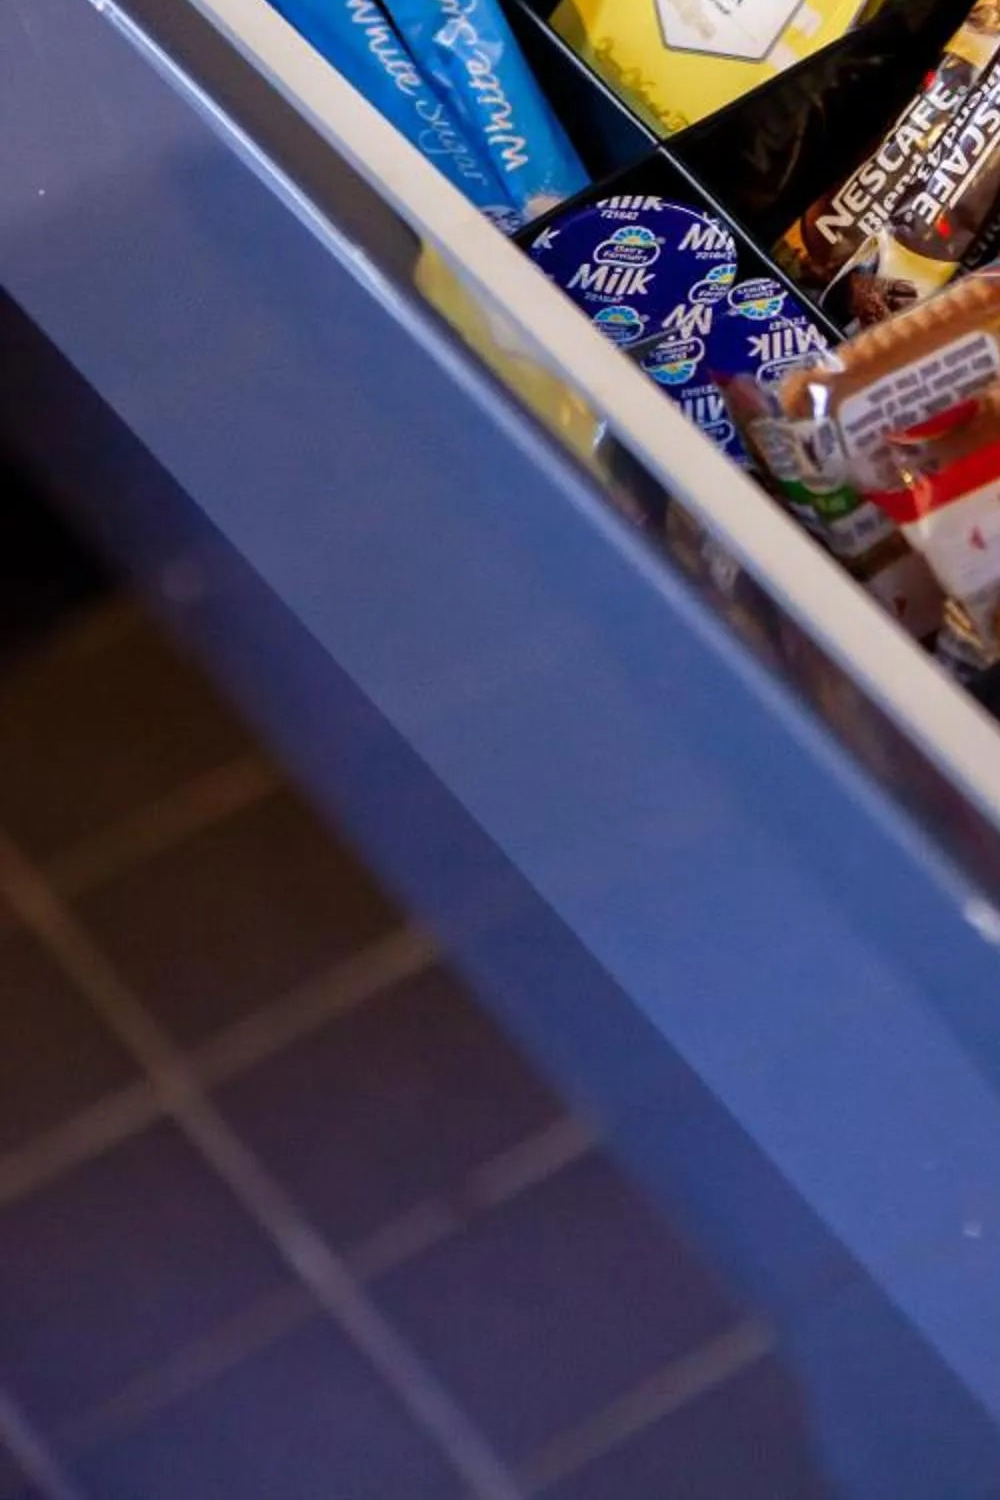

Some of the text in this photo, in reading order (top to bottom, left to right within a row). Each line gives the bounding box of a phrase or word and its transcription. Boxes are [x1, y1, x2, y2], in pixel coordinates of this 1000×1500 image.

[465, 50, 528, 172] White
[415, 100, 489, 187] Sugar
[567, 263, 656, 296] Milk
[746, 324, 828, 361] Milk
